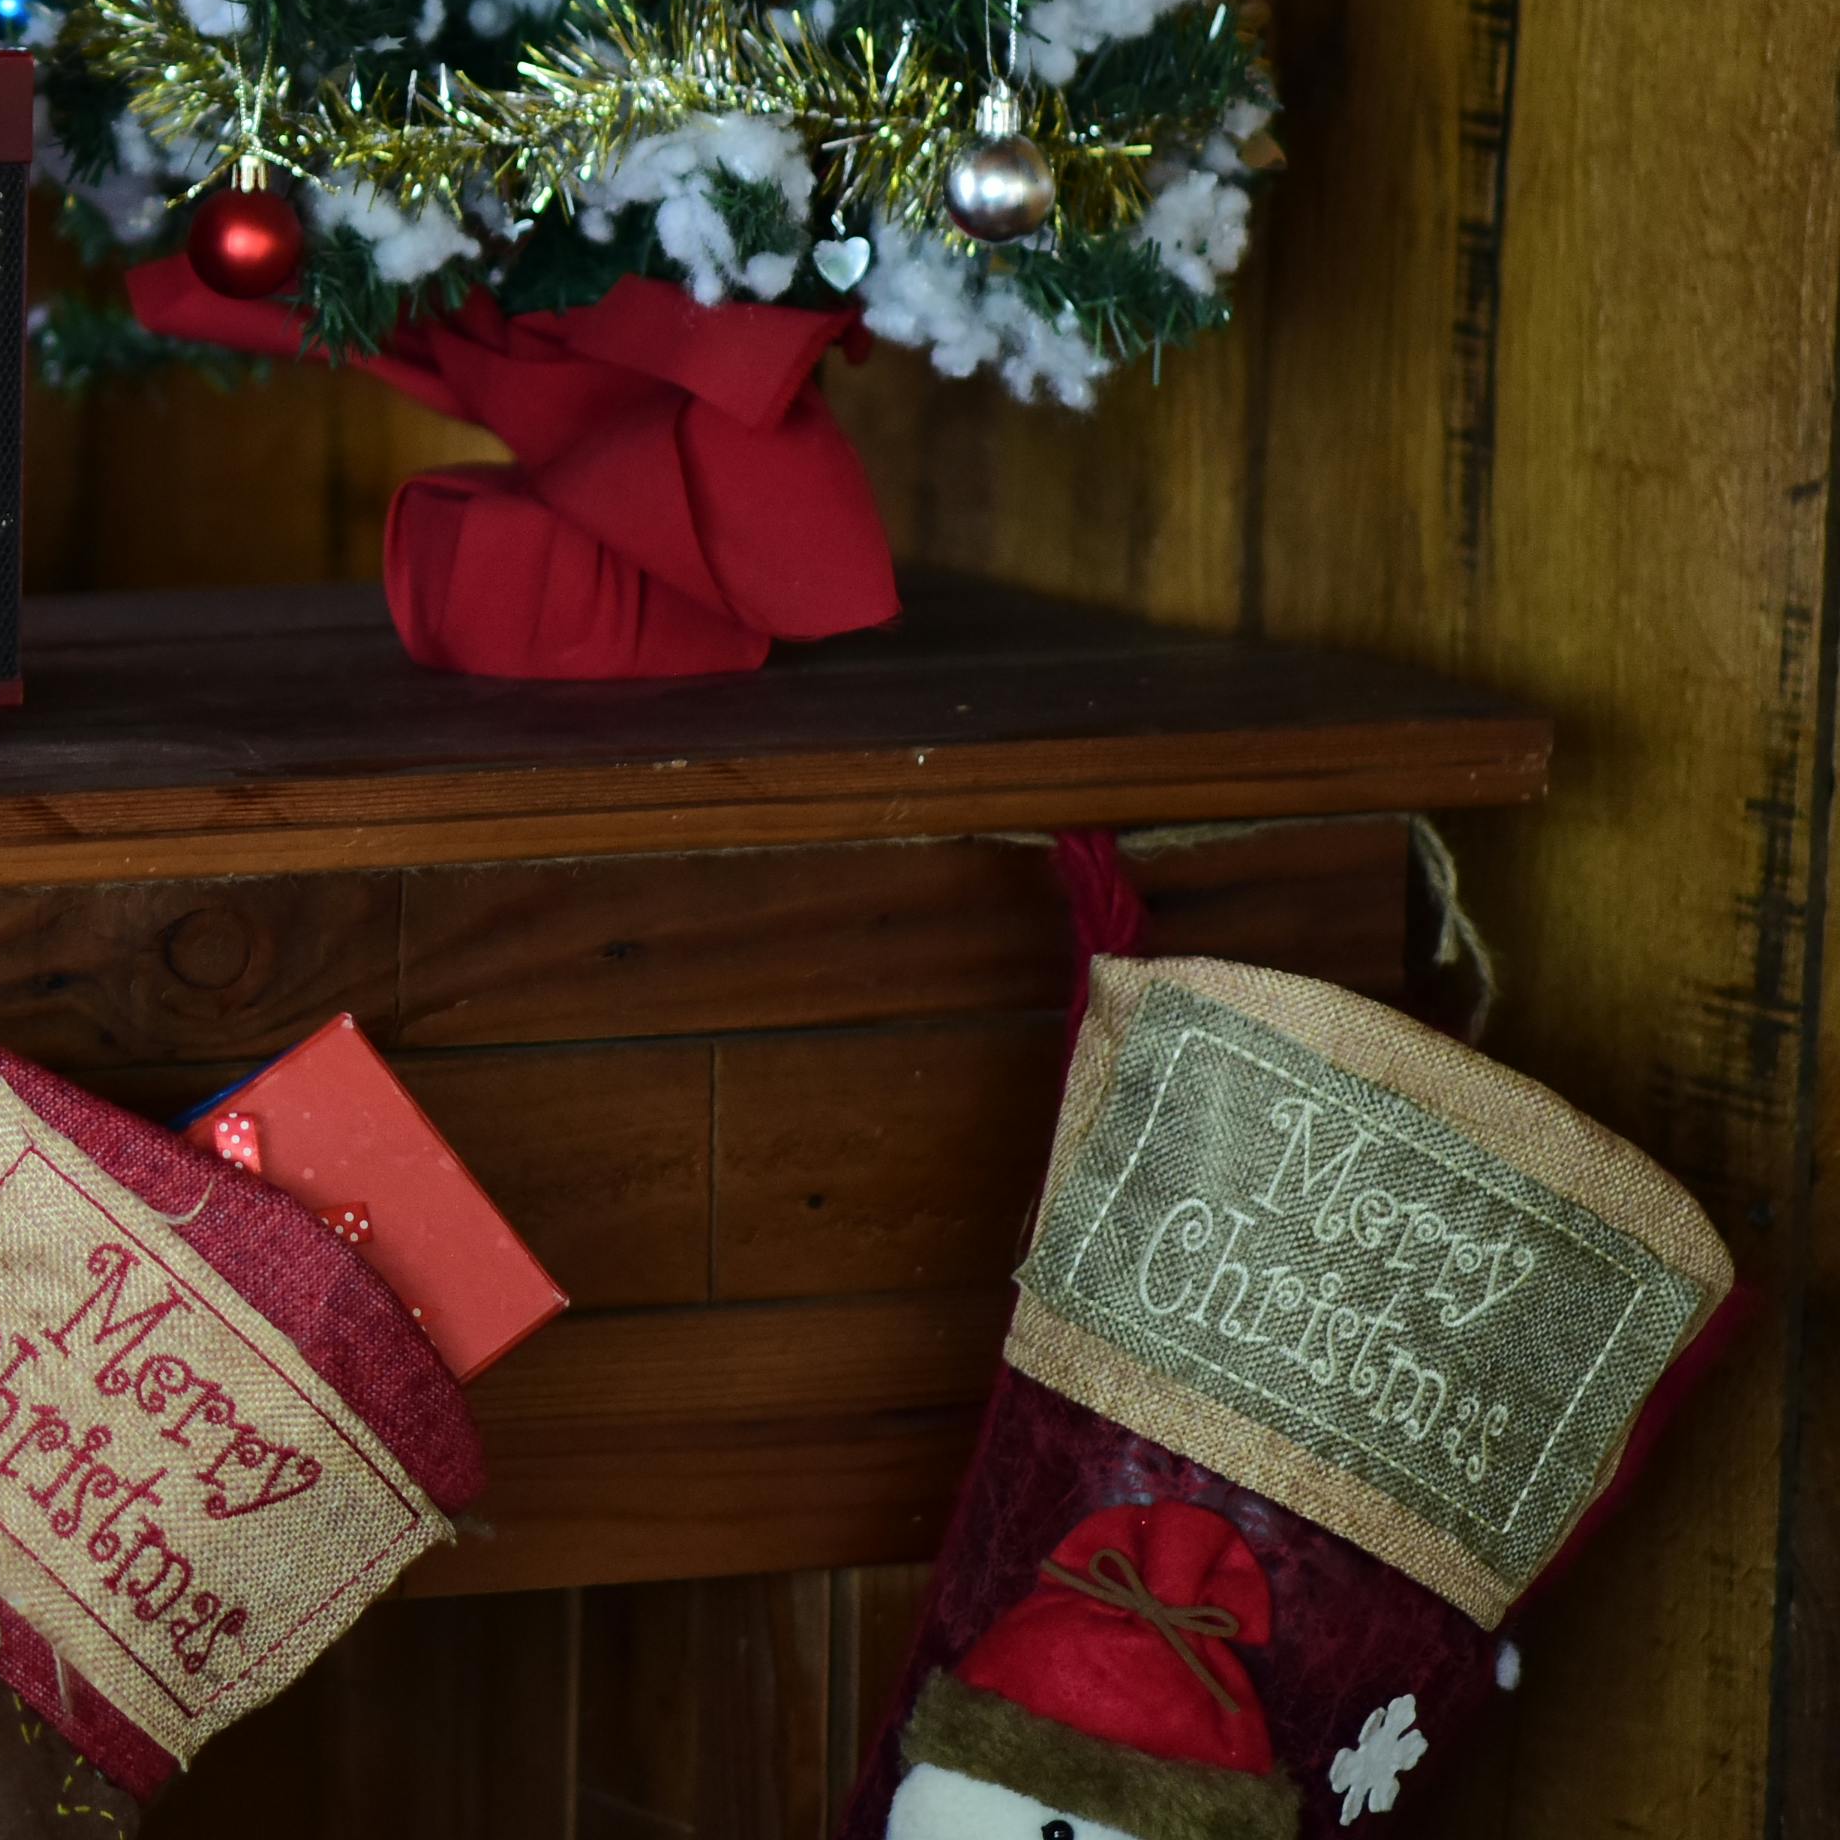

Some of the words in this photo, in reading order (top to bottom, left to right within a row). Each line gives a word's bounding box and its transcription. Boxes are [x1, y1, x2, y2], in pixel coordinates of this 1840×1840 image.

[1138, 1199, 1507, 1482] Christmas
[1254, 1098, 1534, 1328] Merry
[41, 1242, 323, 1521] Merry
